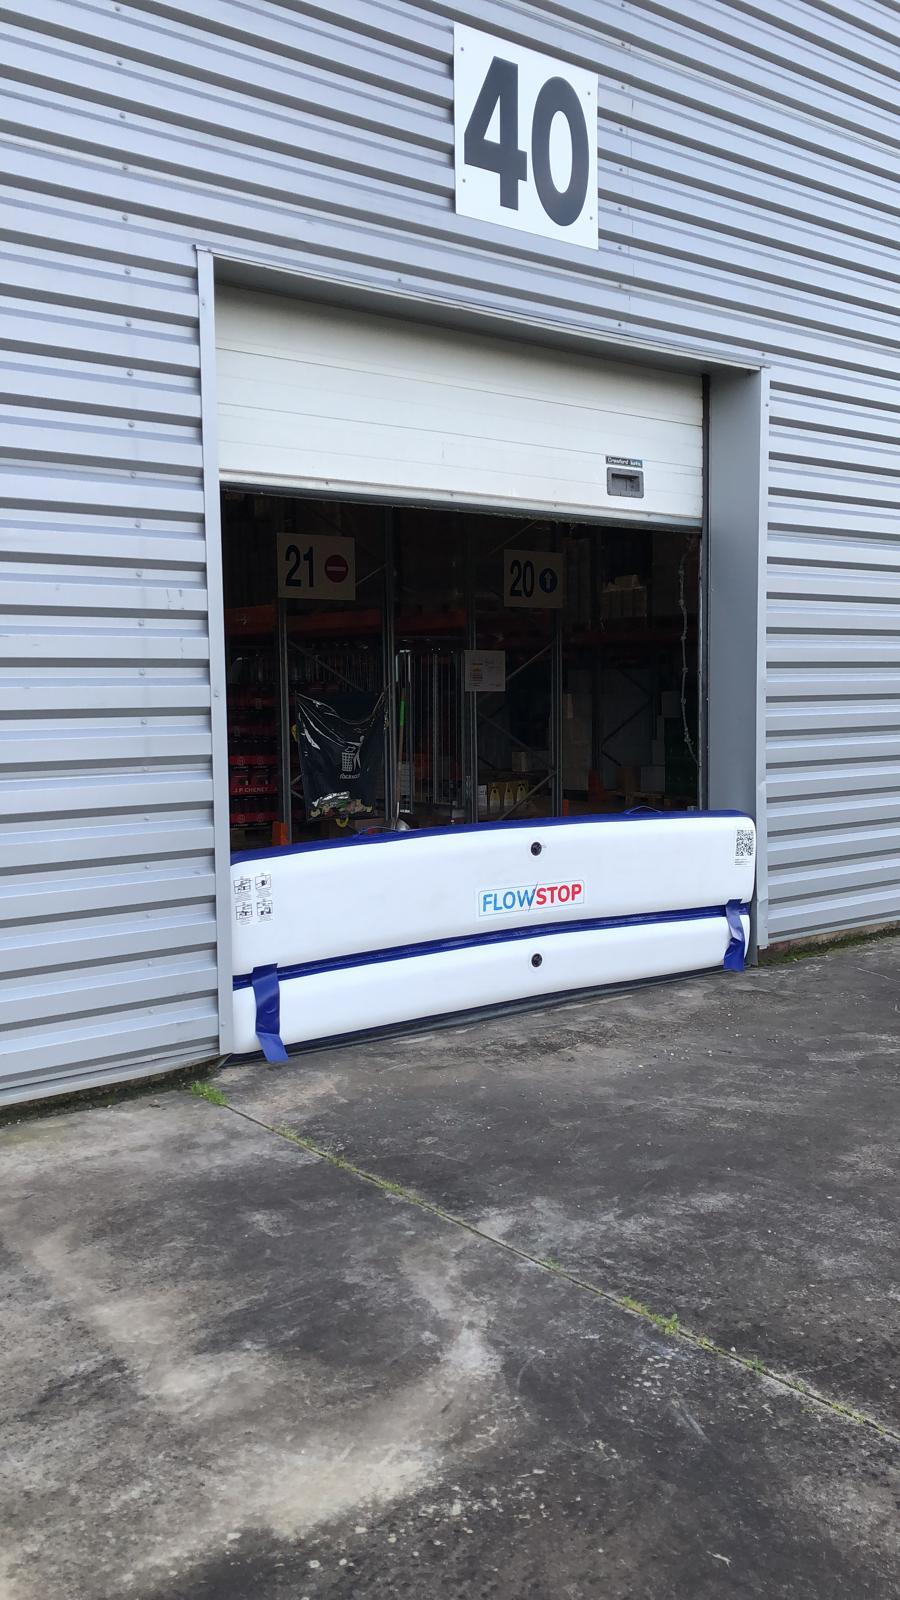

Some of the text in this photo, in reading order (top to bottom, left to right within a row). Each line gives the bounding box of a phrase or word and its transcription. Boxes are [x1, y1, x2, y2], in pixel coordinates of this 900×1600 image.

[464, 55, 590, 227] 40
[285, 544, 314, 588] 21
[510, 559, 535, 598] 20
